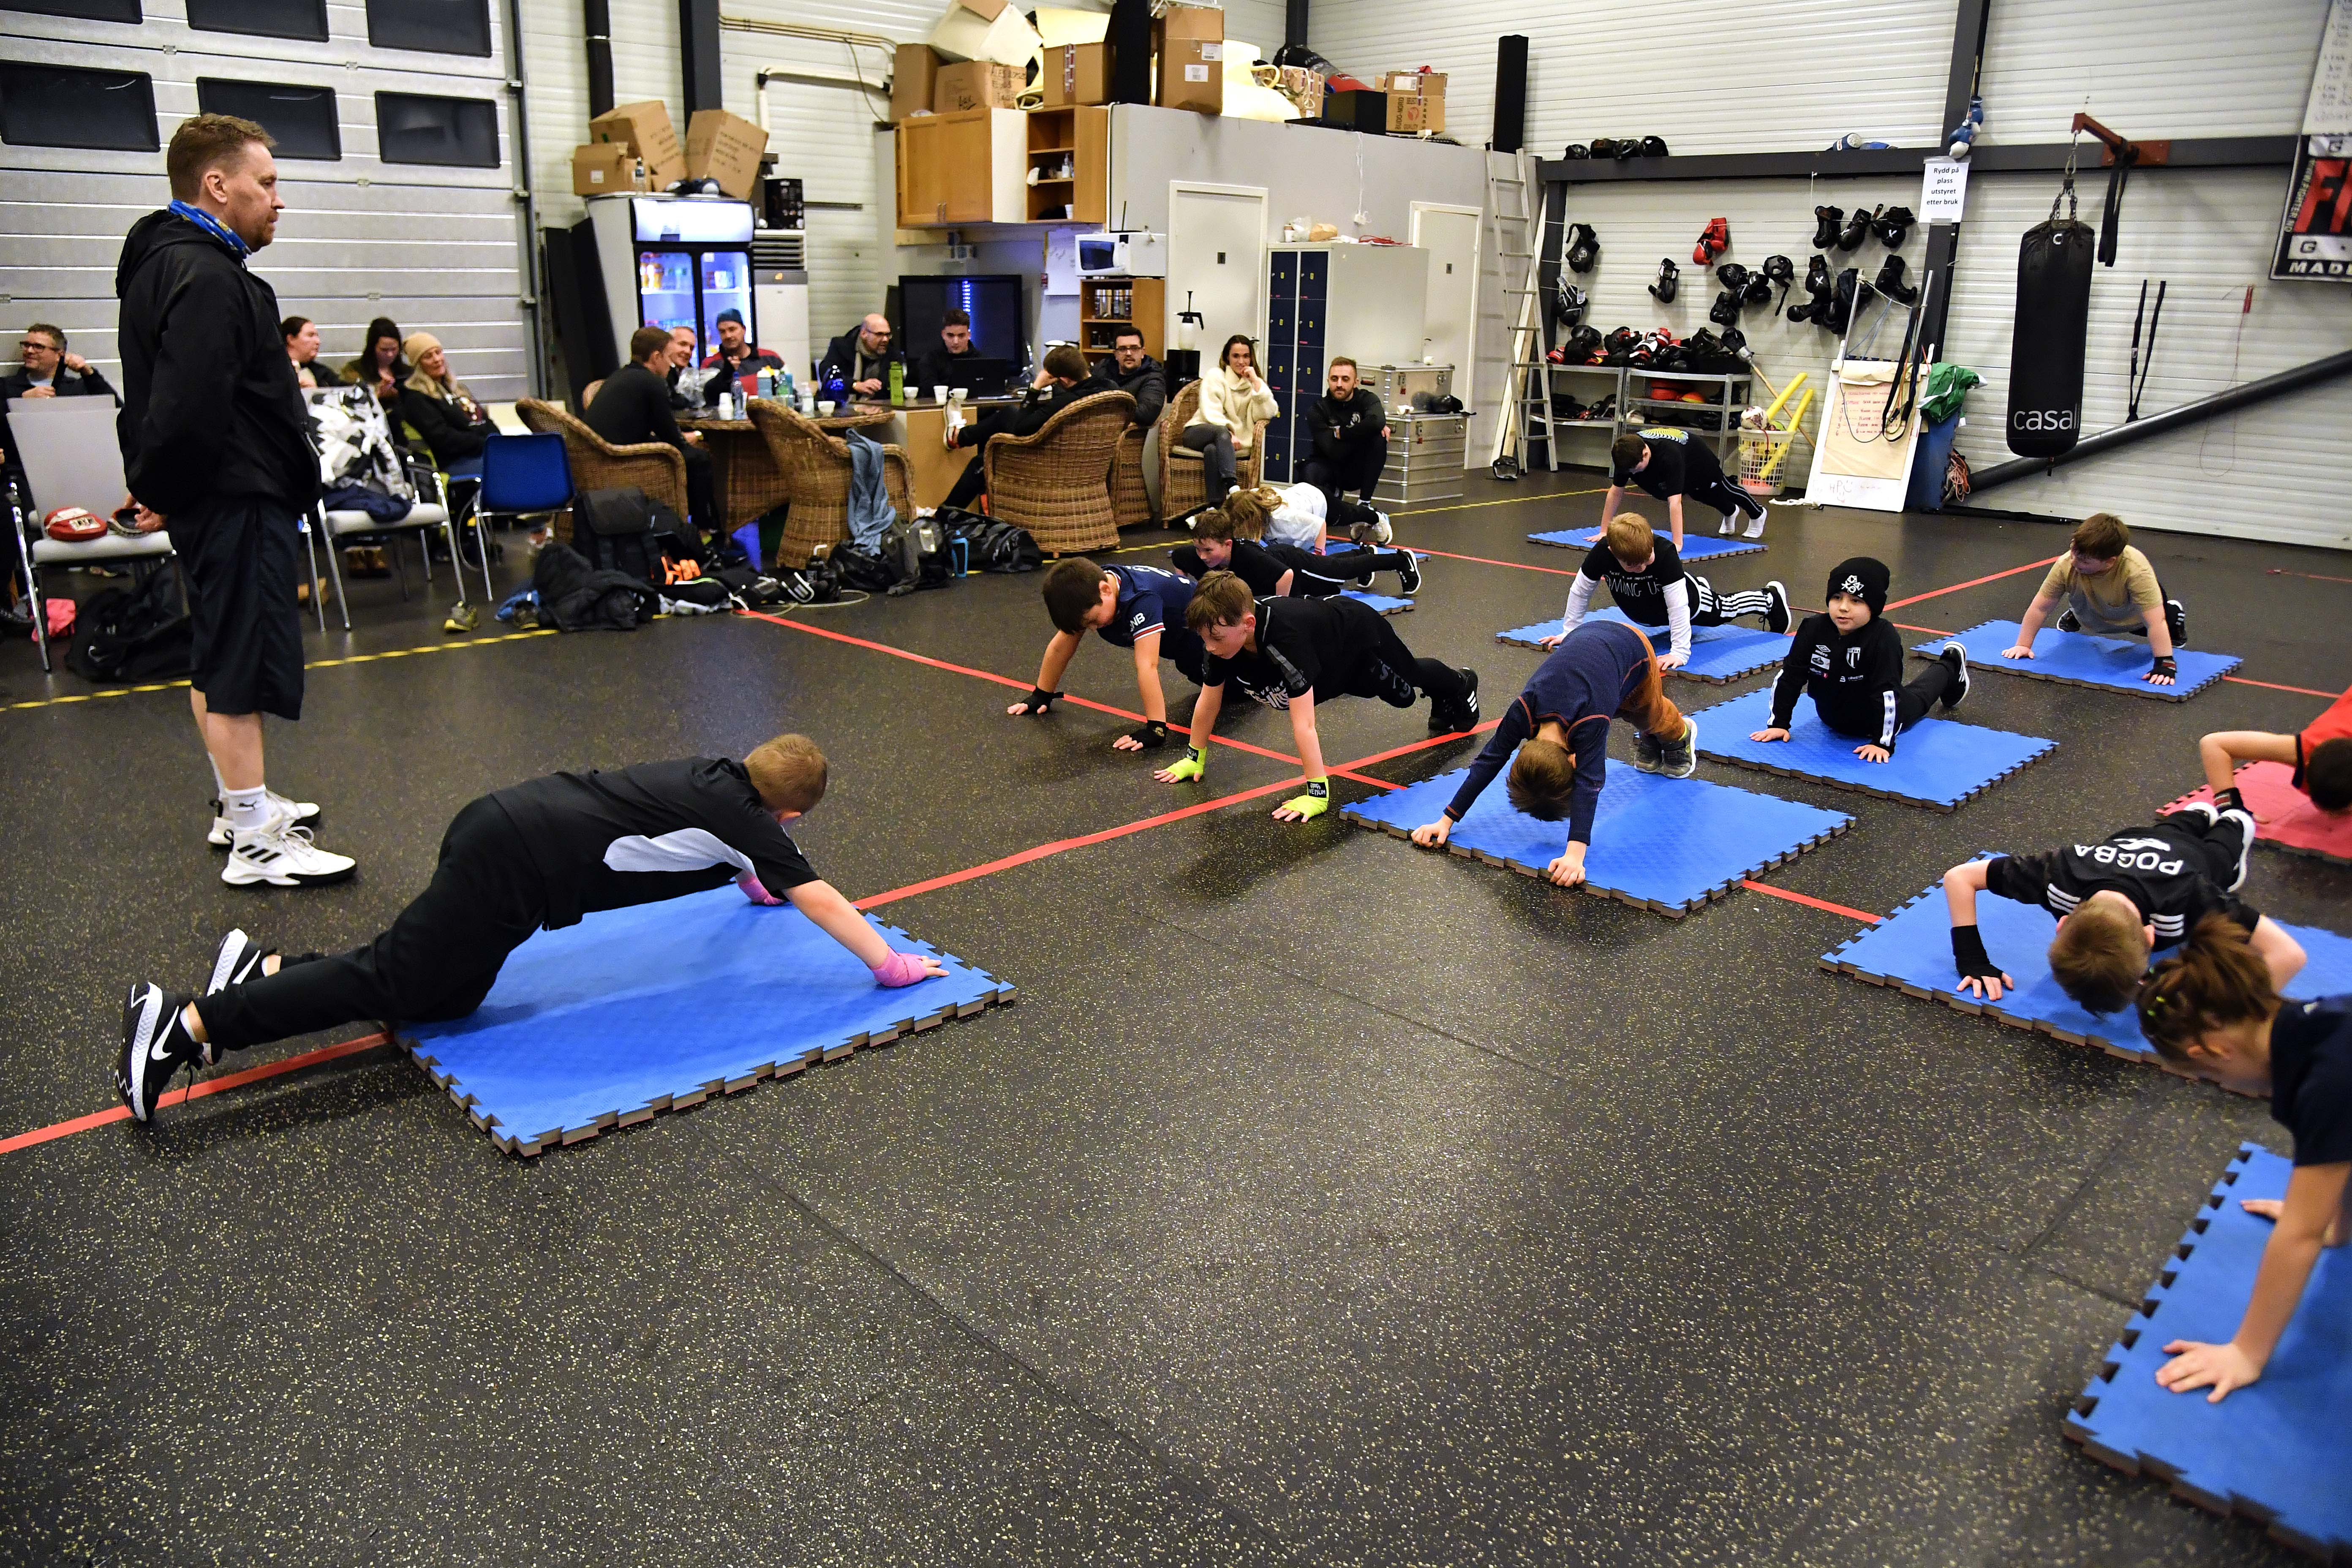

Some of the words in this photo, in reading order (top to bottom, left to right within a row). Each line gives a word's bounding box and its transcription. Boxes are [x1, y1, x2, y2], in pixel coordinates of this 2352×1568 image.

[1130, 612, 1146, 632] NB
[1309, 788, 1326, 796] VENUM
[2074, 844, 2184, 875] POGBA
